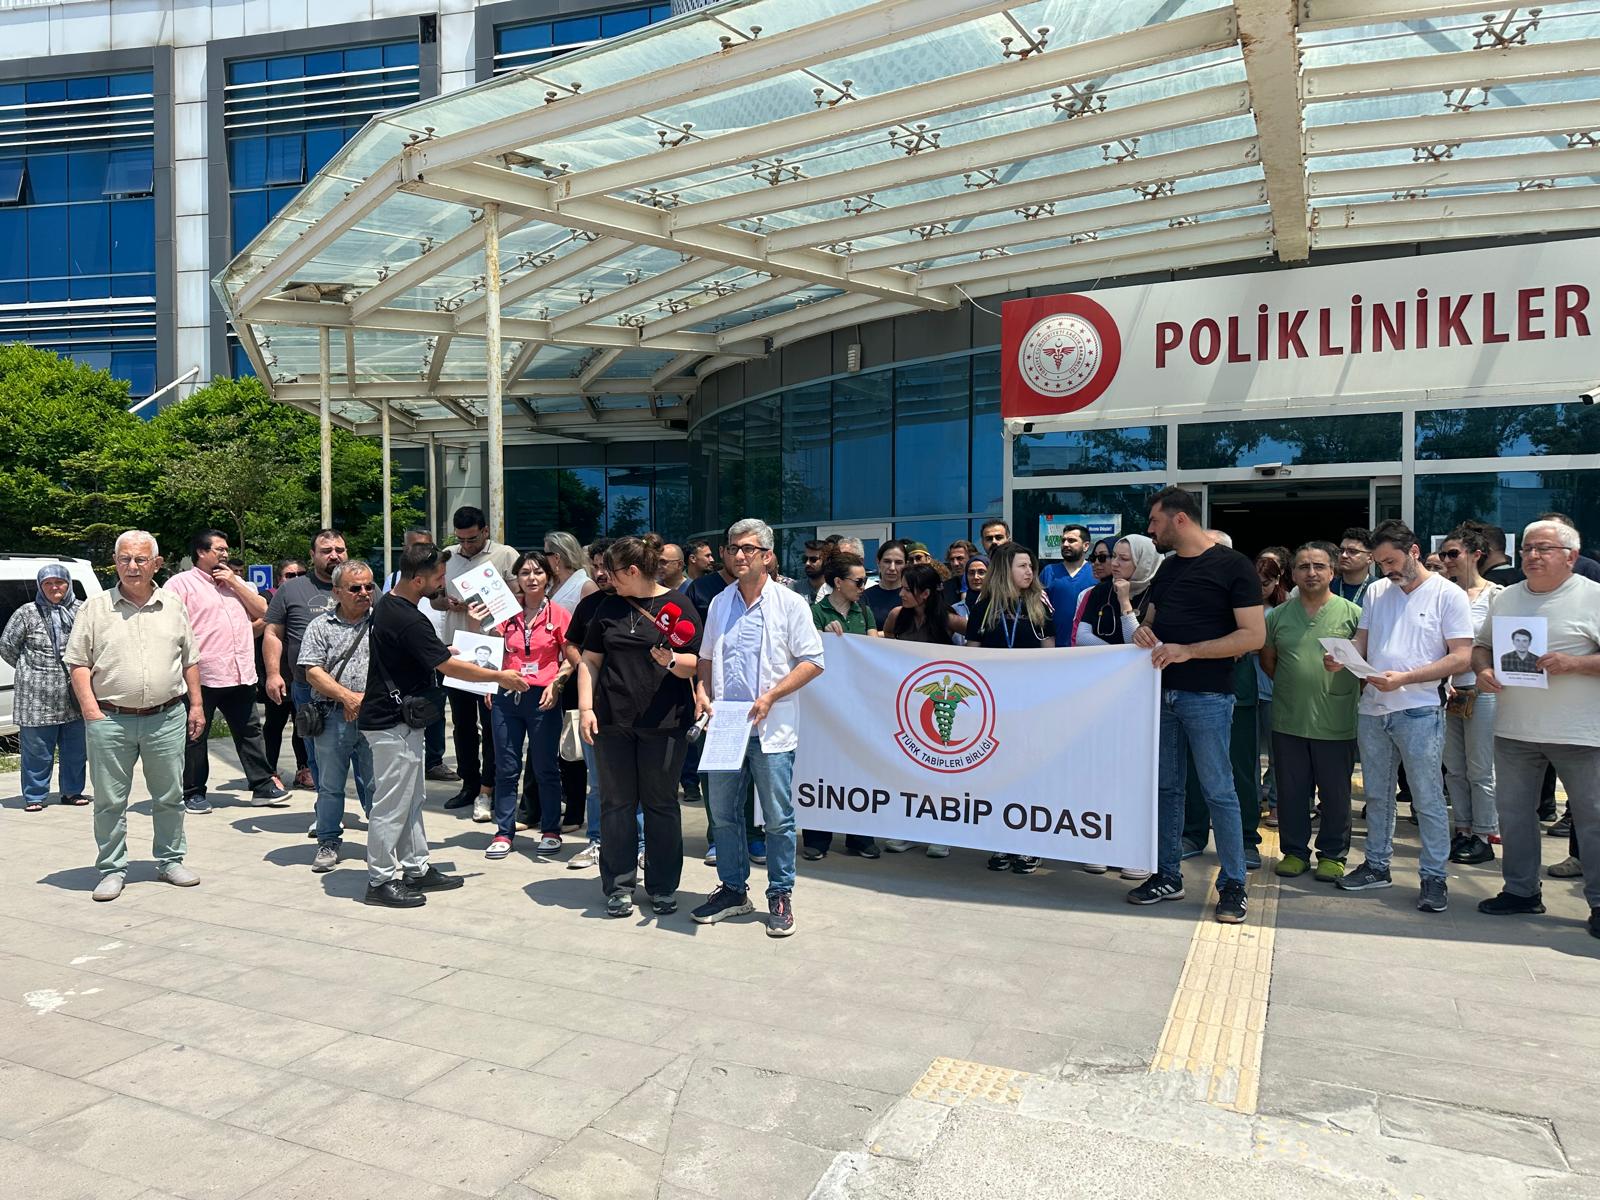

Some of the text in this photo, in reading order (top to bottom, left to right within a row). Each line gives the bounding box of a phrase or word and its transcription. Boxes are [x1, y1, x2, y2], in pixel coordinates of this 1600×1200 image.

[1156, 284, 1591, 368] POLİKLİNİKLER
[901, 733, 993, 768] TÜRK TABİPLERİ BİRLİĞİ
[798, 778, 1112, 841] SİNOP TABİP ODASI
